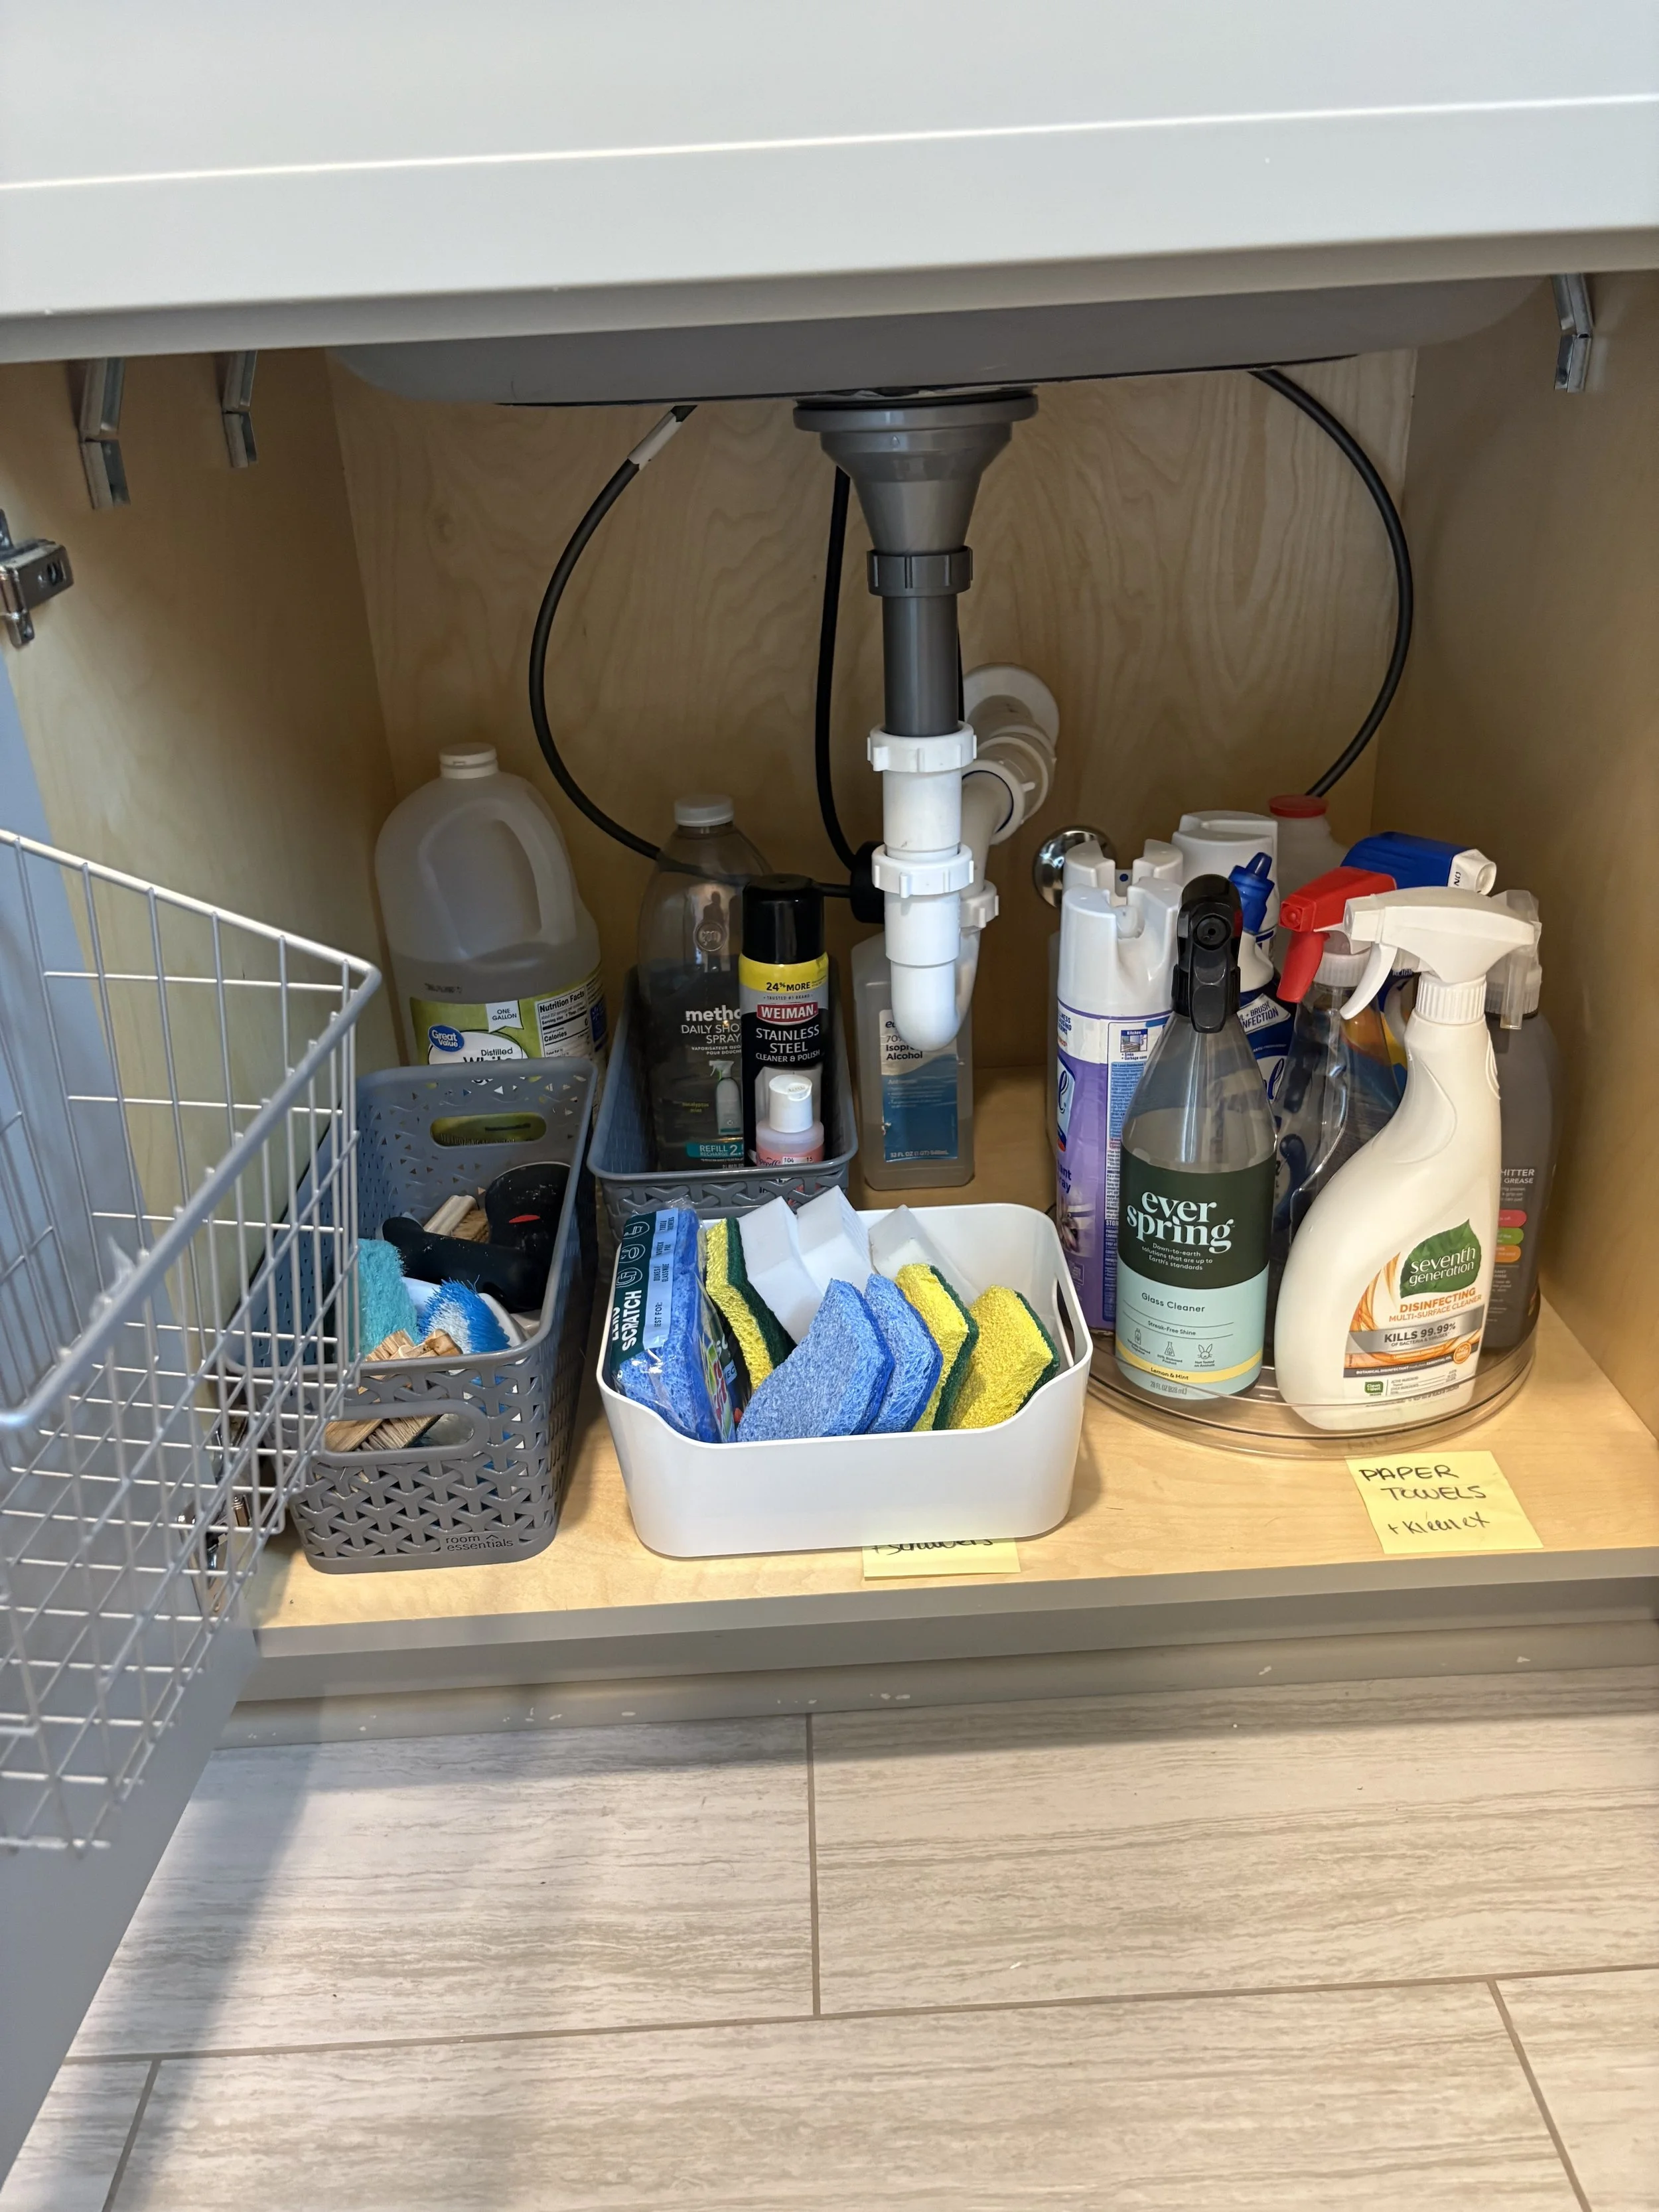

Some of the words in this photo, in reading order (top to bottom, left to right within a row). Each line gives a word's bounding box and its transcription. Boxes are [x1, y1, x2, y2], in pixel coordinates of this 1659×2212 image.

[786, 982, 811, 992] MORE
[540, 997, 569, 1013] Nutrition
[761, 1004, 814, 1019] WEIMAN
[1250, 1003, 1270, 1016] BRUSH
[685, 1004, 741, 1021] metho
[1242, 1006, 1279, 1029] NFECTION
[681, 1025, 712, 1033] DAILY
[715, 1023, 740, 1033] SHO
[756, 1024, 820, 1041] STAINLESS
[431, 1029, 457, 1041] Great
[544, 1031, 567, 1042] Calories
[706, 1033, 741, 1043] SPRAY
[438, 1039, 459, 1047] Value
[770, 1041, 808, 1054] STEEL
[481, 1047, 513, 1056] Distilled
[756, 1053, 788, 1062] CLEANER
[798, 1049, 820, 1061] POLISH
[887, 1051, 923, 1060] Alcohol
[730, 1145, 743, 1155] 2.
[1141, 1191, 1218, 1222] ever
[1126, 1205, 1234, 1254] spring
[1141, 1246, 1167, 1259] solutions
[1153, 1242, 1201, 1257] Down-to-earth
[1149, 1255, 1169, 1266] Earth's
[1170, 1262, 1203, 1270] standards
[1410, 1246, 1476, 1274] seventh
[1409, 1262, 1475, 1287] generation
[1141, 1292, 1164, 1307] Glass
[1167, 1301, 1206, 1313] Cleaner
[1400, 1288, 1476, 1313] DISINFECTING
[654, 1302, 663, 1315] FOR:
[1389, 1305, 1451, 1322] MULTI-SURFACE
[1451, 1294, 1482, 1310] CLEANER
[622, 1290, 642, 1351] SCRATCH
[1147, 1321, 1179, 1333] Streak-Free
[1384, 1331, 1417, 1343] KILLS
[1420, 1322, 1456, 1337] 99.99%
[1399, 1337, 1423, 1346] BACTERIA
[1151, 1367, 1169, 1376] Lemon
[1358, 1464, 1460, 1481] PAPER
[1380, 1485, 1487, 1501] TOWELS
[446, 1535, 480, 1544] room
[447, 1538, 514, 1551] essentials
